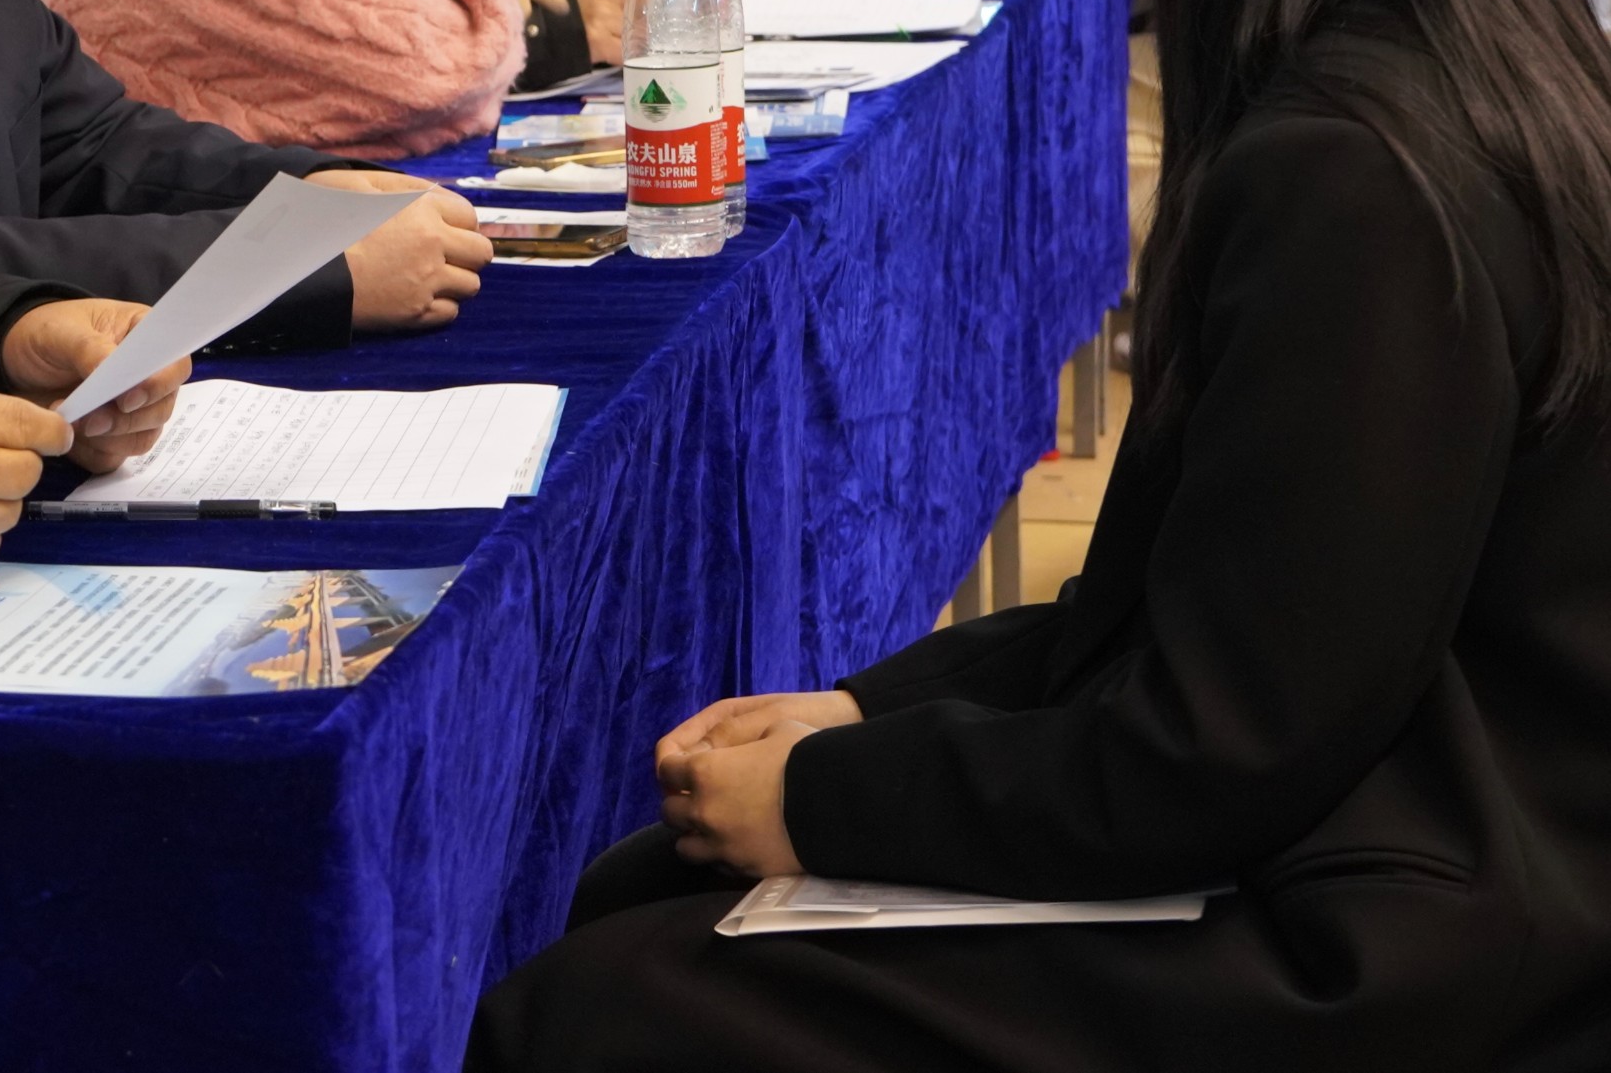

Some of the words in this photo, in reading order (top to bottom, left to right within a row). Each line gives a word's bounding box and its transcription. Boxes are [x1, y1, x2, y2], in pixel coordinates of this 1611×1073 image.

[627, 141, 697, 165] 农夫山泉
[659, 166, 697, 178] SPRING
